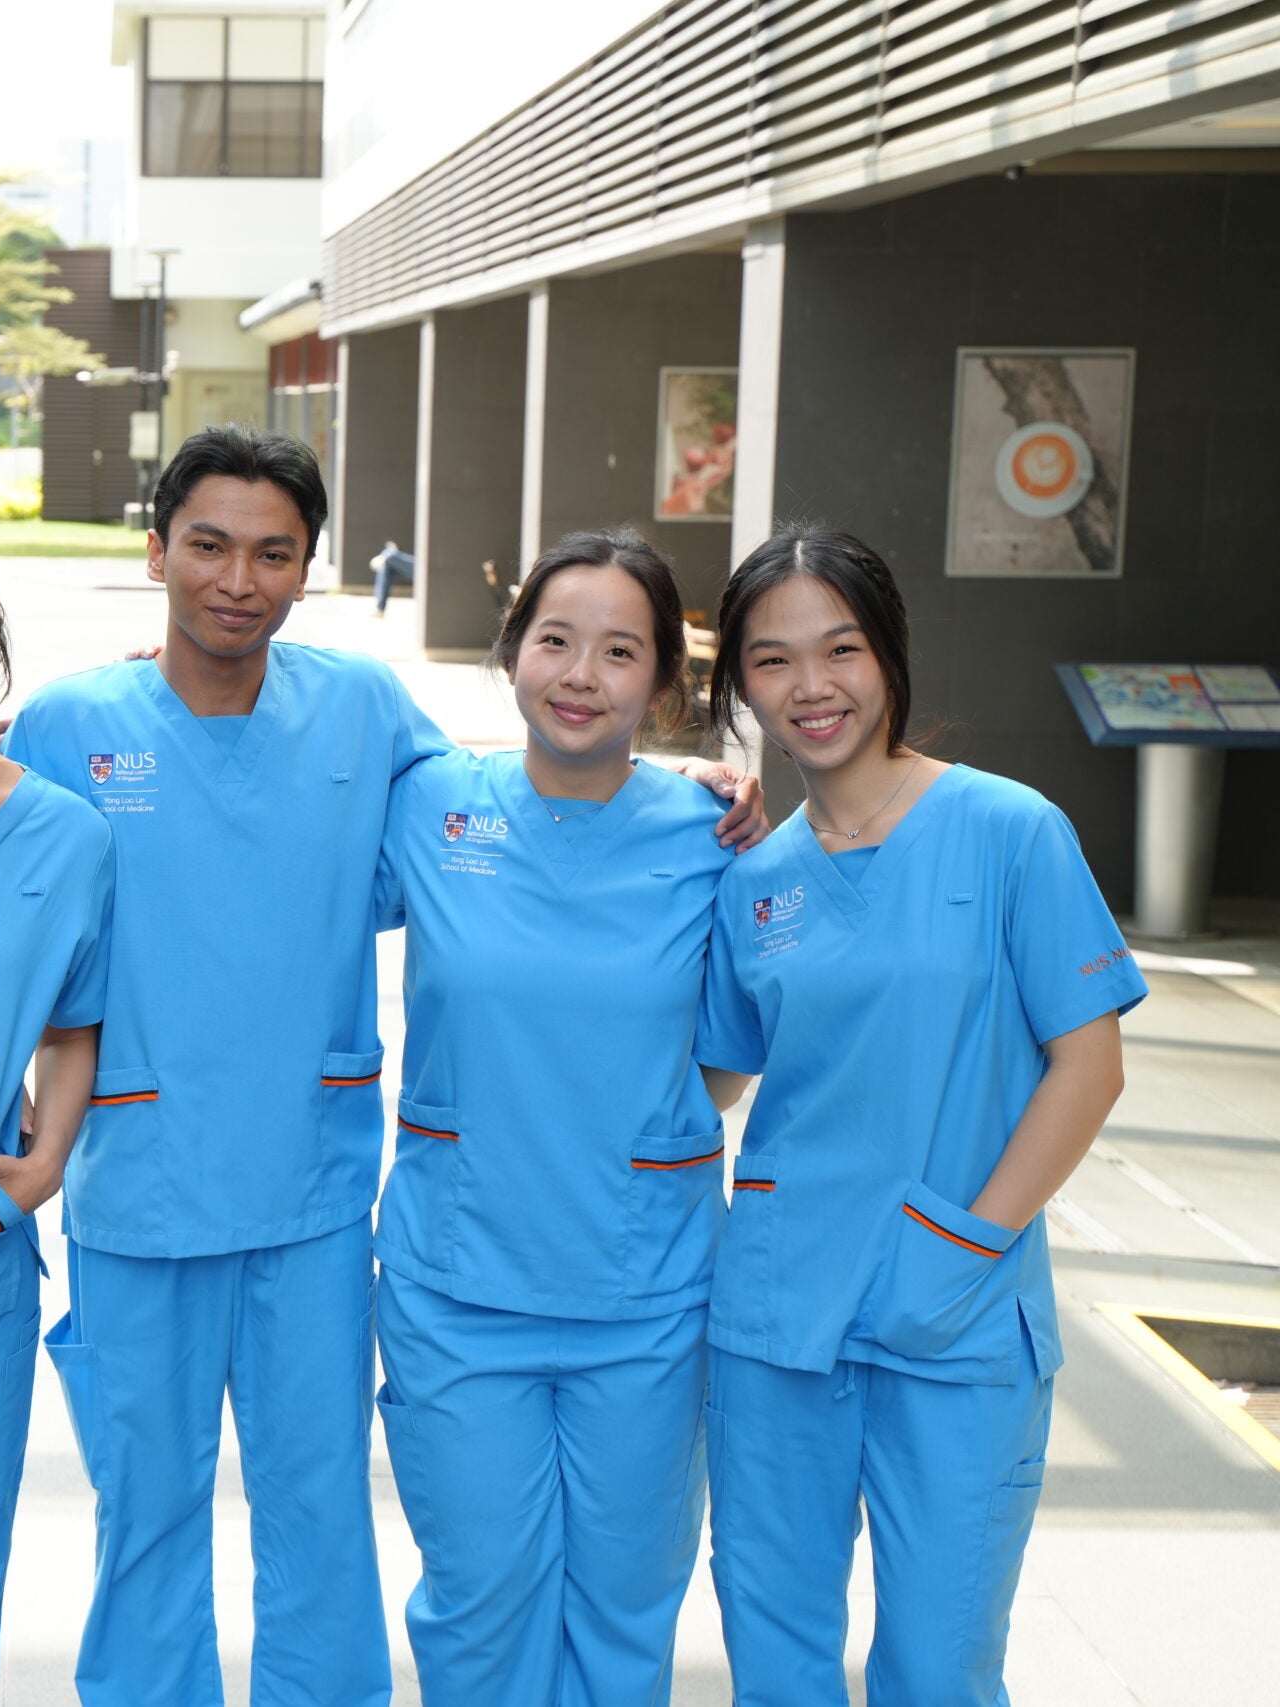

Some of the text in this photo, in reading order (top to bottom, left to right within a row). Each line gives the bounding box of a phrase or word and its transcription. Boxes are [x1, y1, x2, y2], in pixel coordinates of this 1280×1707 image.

[115, 751, 156, 769] NUS
[104, 796, 120, 805] Yong
[121, 796, 134, 804] Loo
[468, 814, 509, 834] NUS
[451, 855, 465, 865] Yong
[466, 857, 478, 865] Loo
[440, 863, 497, 876] School of Medicine
[773, 886, 804, 910] NUS
[1079, 954, 1111, 977] NUS
